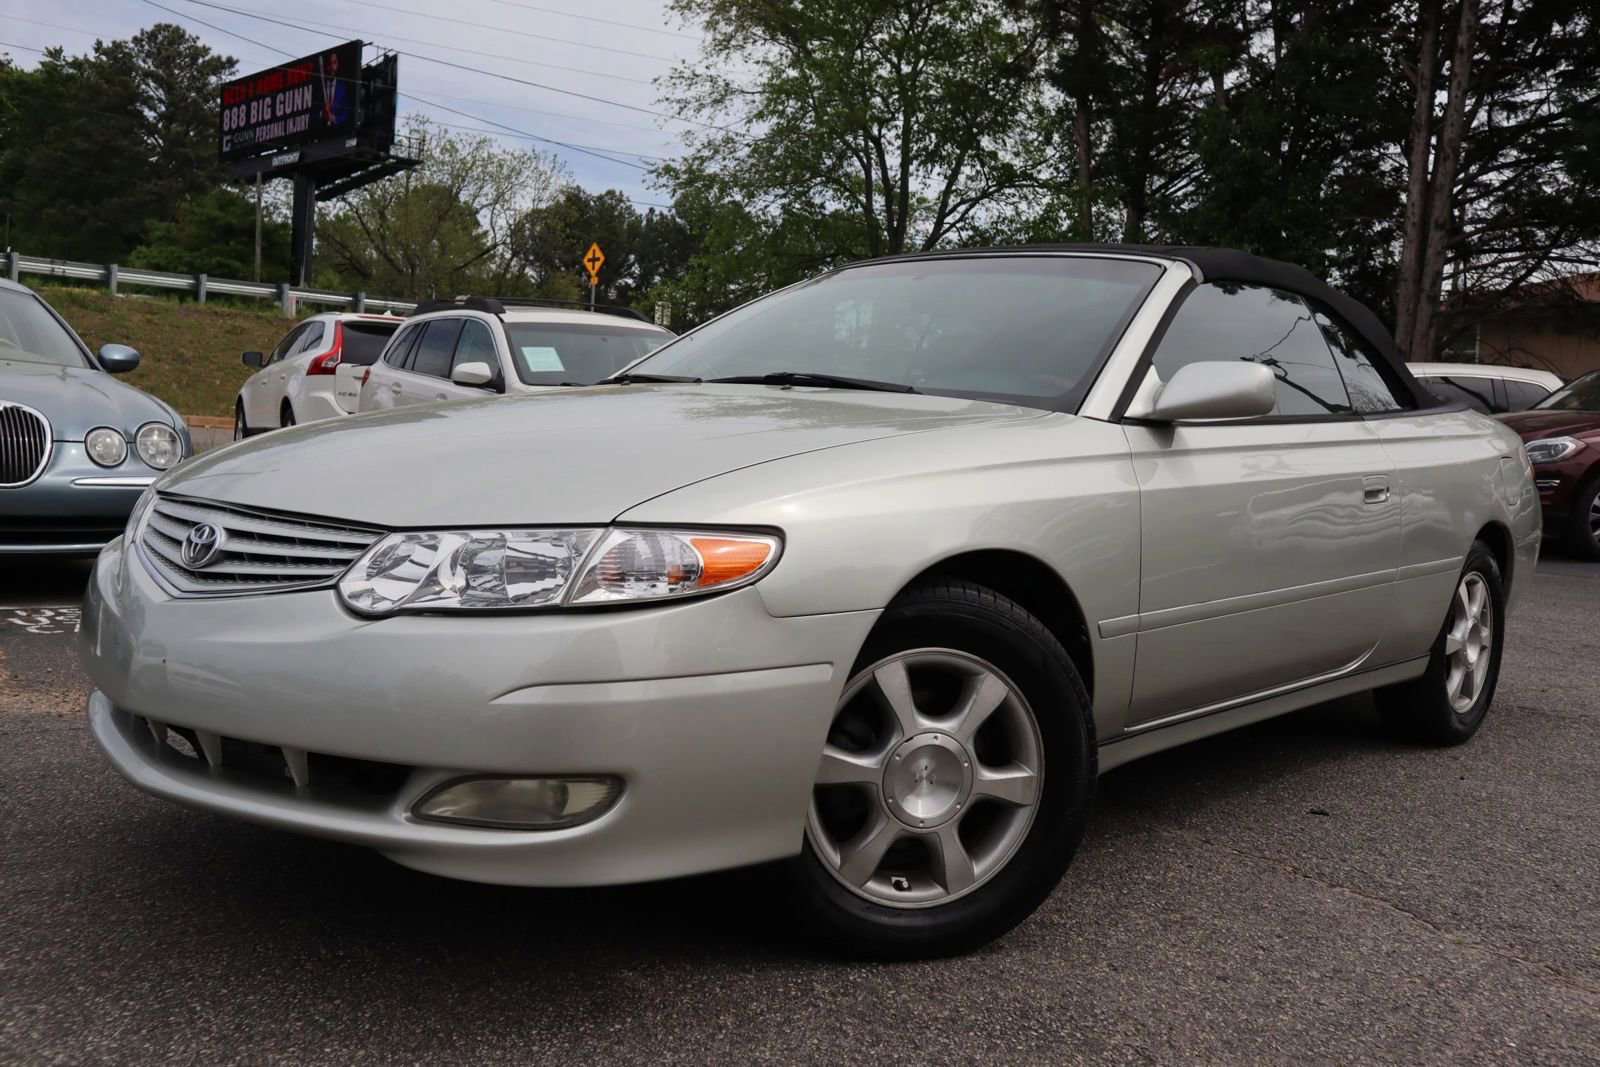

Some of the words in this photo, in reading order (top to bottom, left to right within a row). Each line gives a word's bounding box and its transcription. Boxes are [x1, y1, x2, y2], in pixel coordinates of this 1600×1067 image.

[223, 104, 247, 132] 888
[250, 97, 272, 125] BIG
[275, 84, 313, 118] GUNN
[233, 128, 255, 143] GUNN
[255, 120, 285, 143] PERSONAL
[286, 113, 310, 135] INJURY
